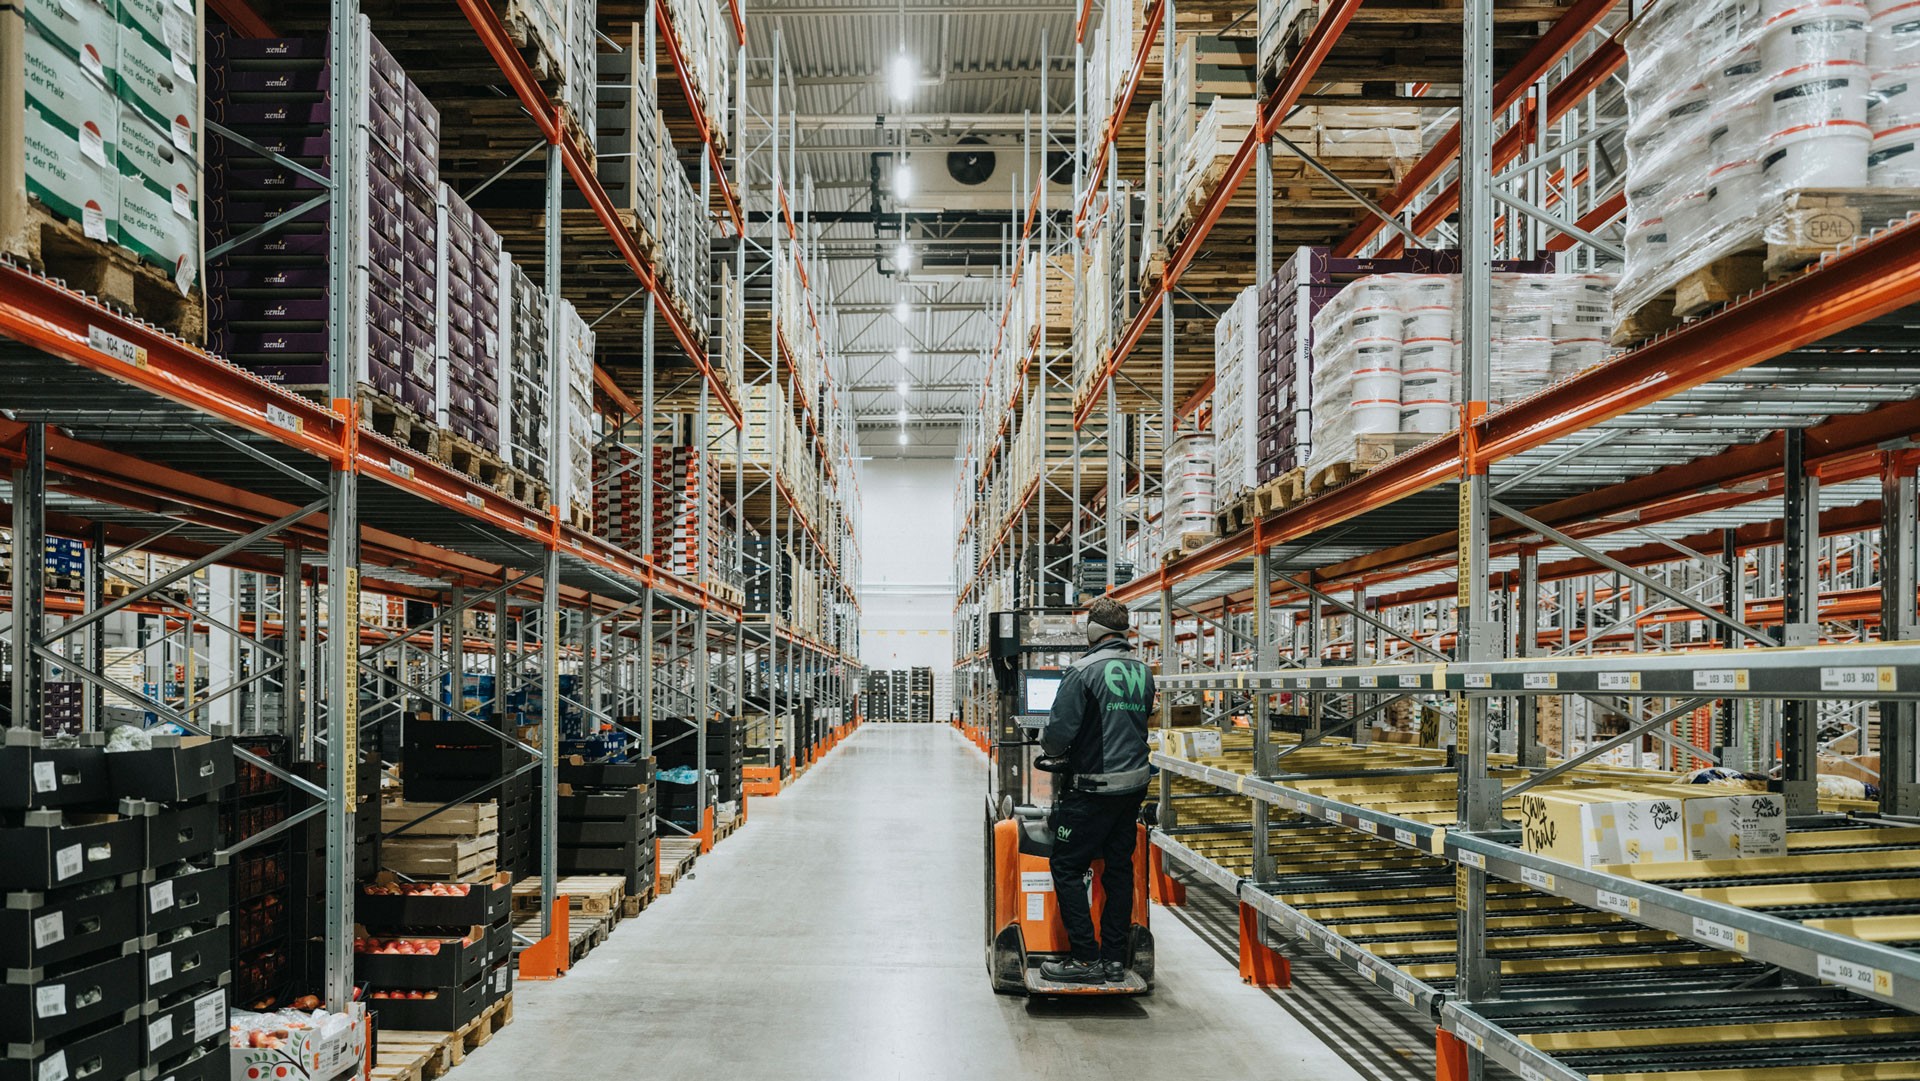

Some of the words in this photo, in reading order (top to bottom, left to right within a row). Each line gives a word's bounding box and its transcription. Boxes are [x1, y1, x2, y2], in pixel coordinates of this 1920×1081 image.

[145, 4, 160, 23] Pfalz
[265, 43, 287, 54] xenia
[123, 47, 156, 78] Erntefrisch
[31, 73, 45, 87] der
[46, 80, 64, 100] Pfalz
[122, 64, 135, 76] aus
[136, 71, 146, 87] der
[146, 78, 162, 97] Pfalz
[265, 76, 287, 87] xenia
[264, 109, 286, 119] xenia
[122, 122, 156, 149] Erntefrisch
[121, 137, 134, 150] aus
[135, 143, 146, 158] der
[146, 150, 162, 168] Pfalz
[33, 155, 47, 170] der
[49, 164, 67, 182] Pfalz
[263, 174, 285, 185] xenia
[124, 197, 158, 224] Erntefrisch
[123, 213, 135, 226] aus
[136, 218, 148, 232] der
[150, 224, 165, 240] Pfalz
[1811, 220, 1847, 238] EPAL
[264, 240, 286, 250] xenia
[264, 272, 286, 283] xenia
[264, 305, 286, 316] xenia
[106, 337, 118, 352] 104
[122, 344, 134, 359] 102
[264, 338, 286, 348] xenia
[1610, 676, 1618, 684] 103
[1621, 676, 1629, 684] 304
[1709, 674, 1720, 684] 103
[1723, 674, 1734, 684] 303
[1842, 673, 1856, 683] 103
[1861, 673, 1875, 683] 302
[1881, 672, 1891, 683] 40
[1522, 795, 1548, 828] Salla
[1650, 801, 1672, 820] Salla
[1752, 796, 1774, 813] Salla
[1654, 811, 1680, 831] Carte
[1527, 812, 1557, 854] Carte
[1609, 896, 1617, 905] 103
[1620, 899, 1628, 908] 204
[1709, 925, 1719, 936] 103
[1722, 930, 1733, 941] 203
[1839, 966, 1853, 978] 103
[1857, 971, 1872, 983] 202
